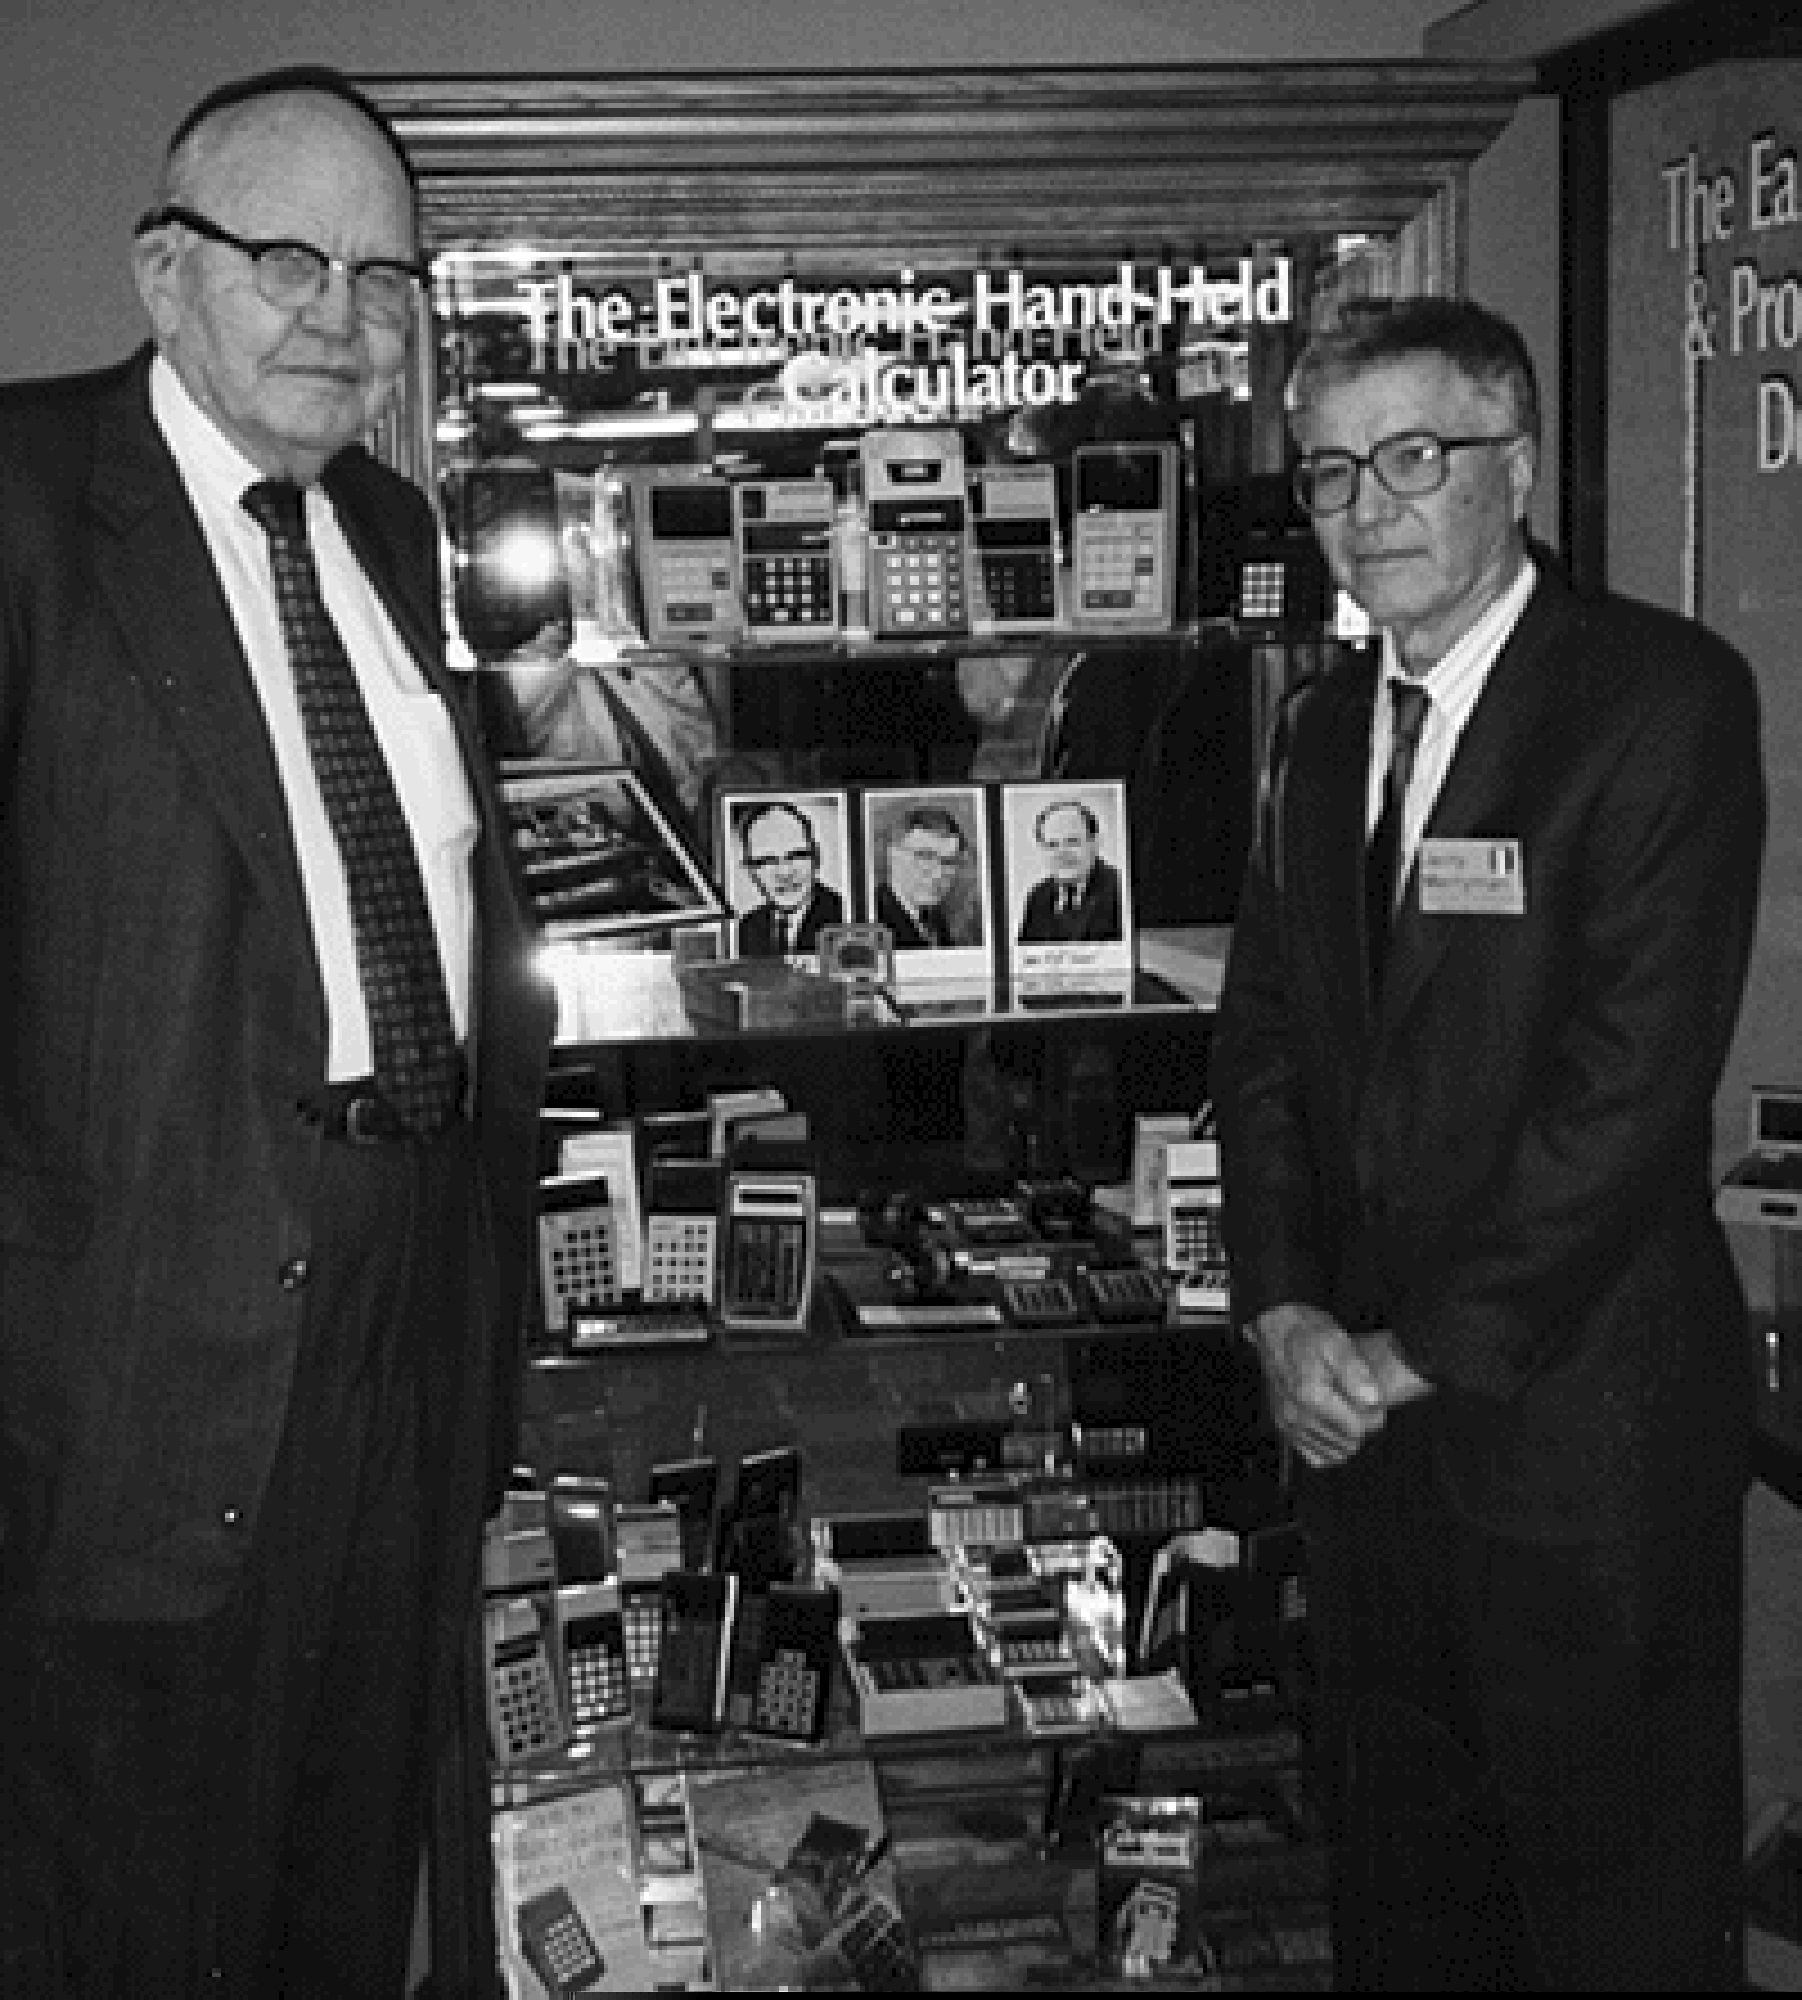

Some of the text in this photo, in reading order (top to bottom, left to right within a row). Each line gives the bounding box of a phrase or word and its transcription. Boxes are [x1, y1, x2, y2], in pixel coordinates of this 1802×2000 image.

[1661, 151, 1735, 250] The
[515, 273, 631, 339] The
[656, 266, 952, 339] Electronic
[1683, 264, 1802, 358] & Pro
[781, 341, 1084, 406] Calculator
[1756, 380, 1802, 474] D
